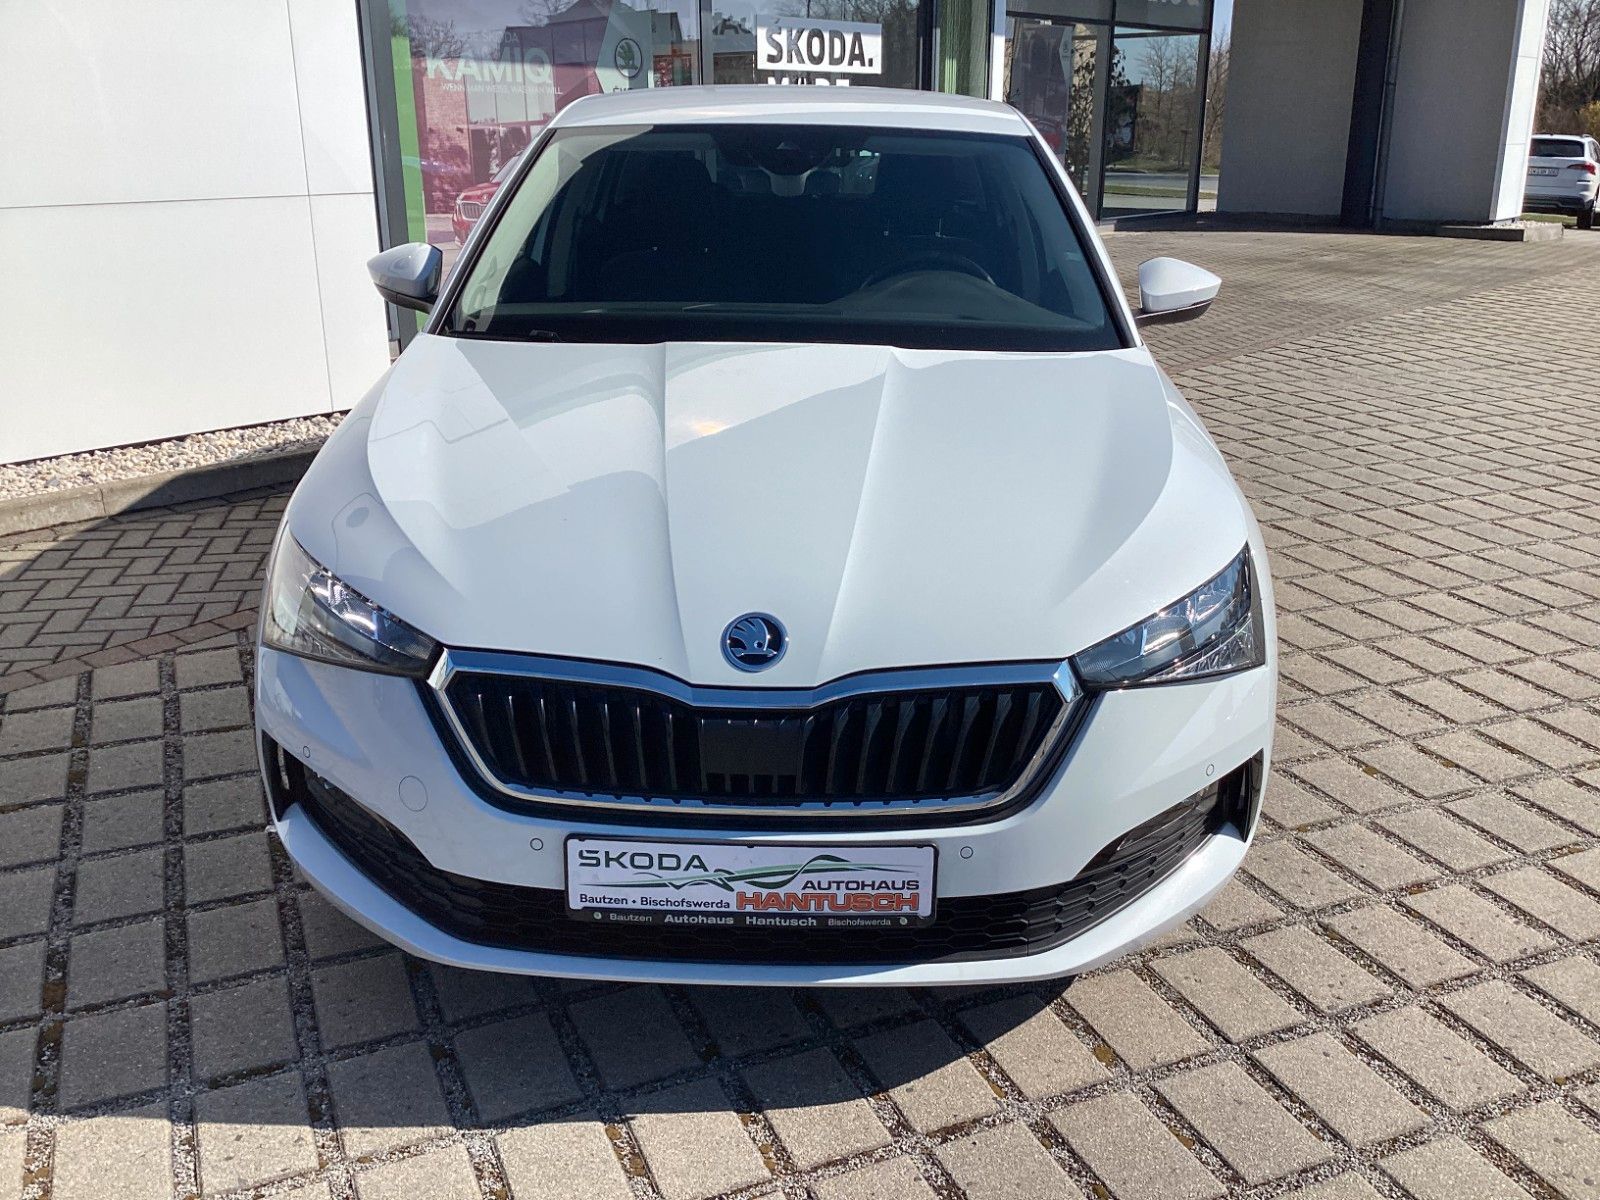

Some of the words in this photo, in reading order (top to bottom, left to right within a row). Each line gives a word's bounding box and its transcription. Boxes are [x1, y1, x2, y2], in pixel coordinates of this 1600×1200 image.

[425, 47, 554, 84] KAMIQ
[802, 879, 919, 891] AUTOHAUS
[579, 893, 628, 905] Bautzen
[640, 896, 730, 909] Bischofswerda
[736, 891, 921, 912] HANTUSCH
[609, 913, 652, 922] Bautzen
[664, 914, 734, 925] Autohaus
[745, 916, 817, 927] Hantusch
[828, 918, 891, 927] Bischofswerda
